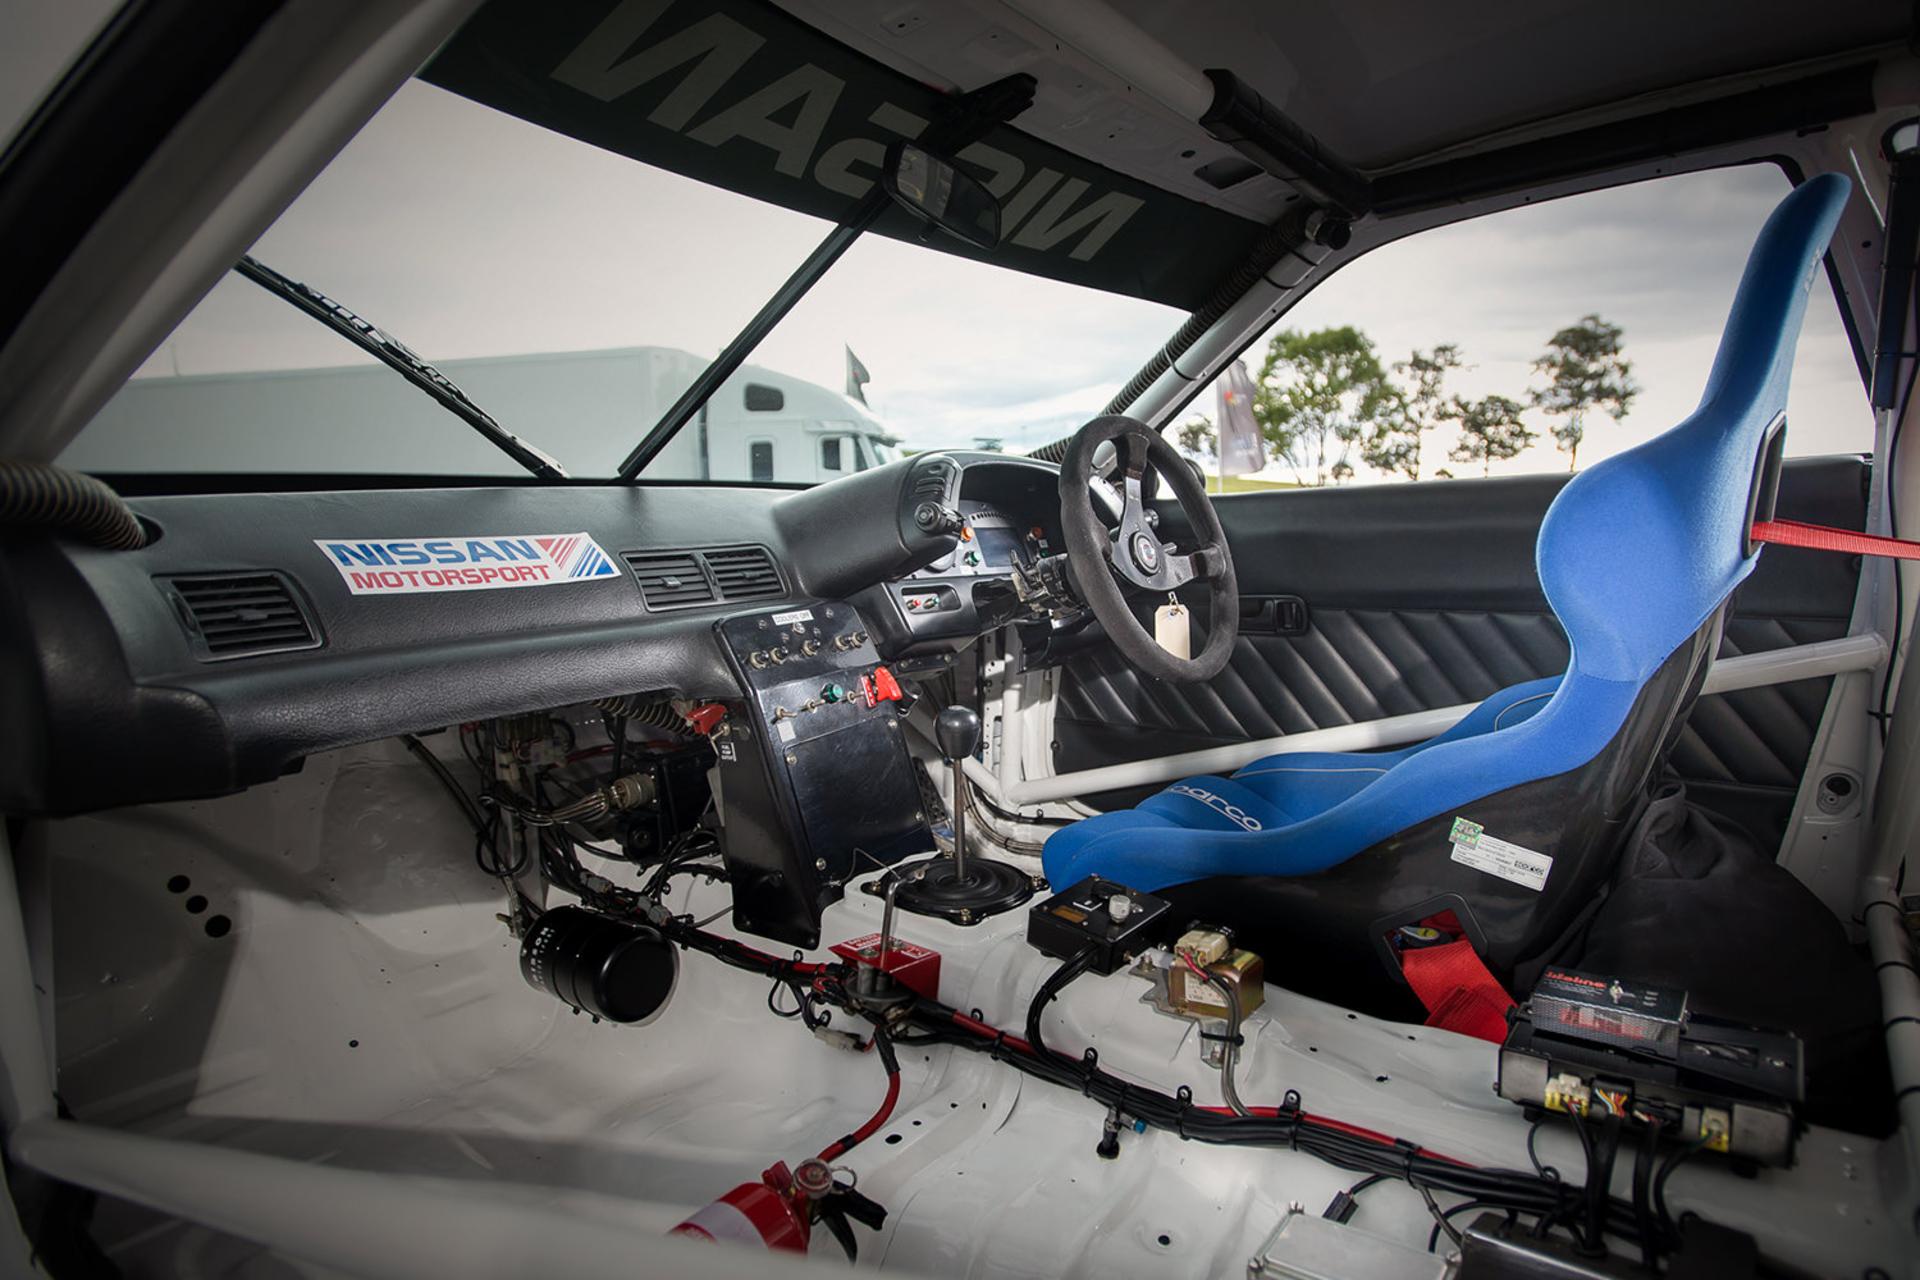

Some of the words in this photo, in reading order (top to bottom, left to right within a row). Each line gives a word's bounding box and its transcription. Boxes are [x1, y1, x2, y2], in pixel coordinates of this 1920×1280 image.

[326, 538, 541, 567] NISSAN
[349, 564, 552, 590] MOTORSPORT
[1168, 785, 1263, 832] parco
